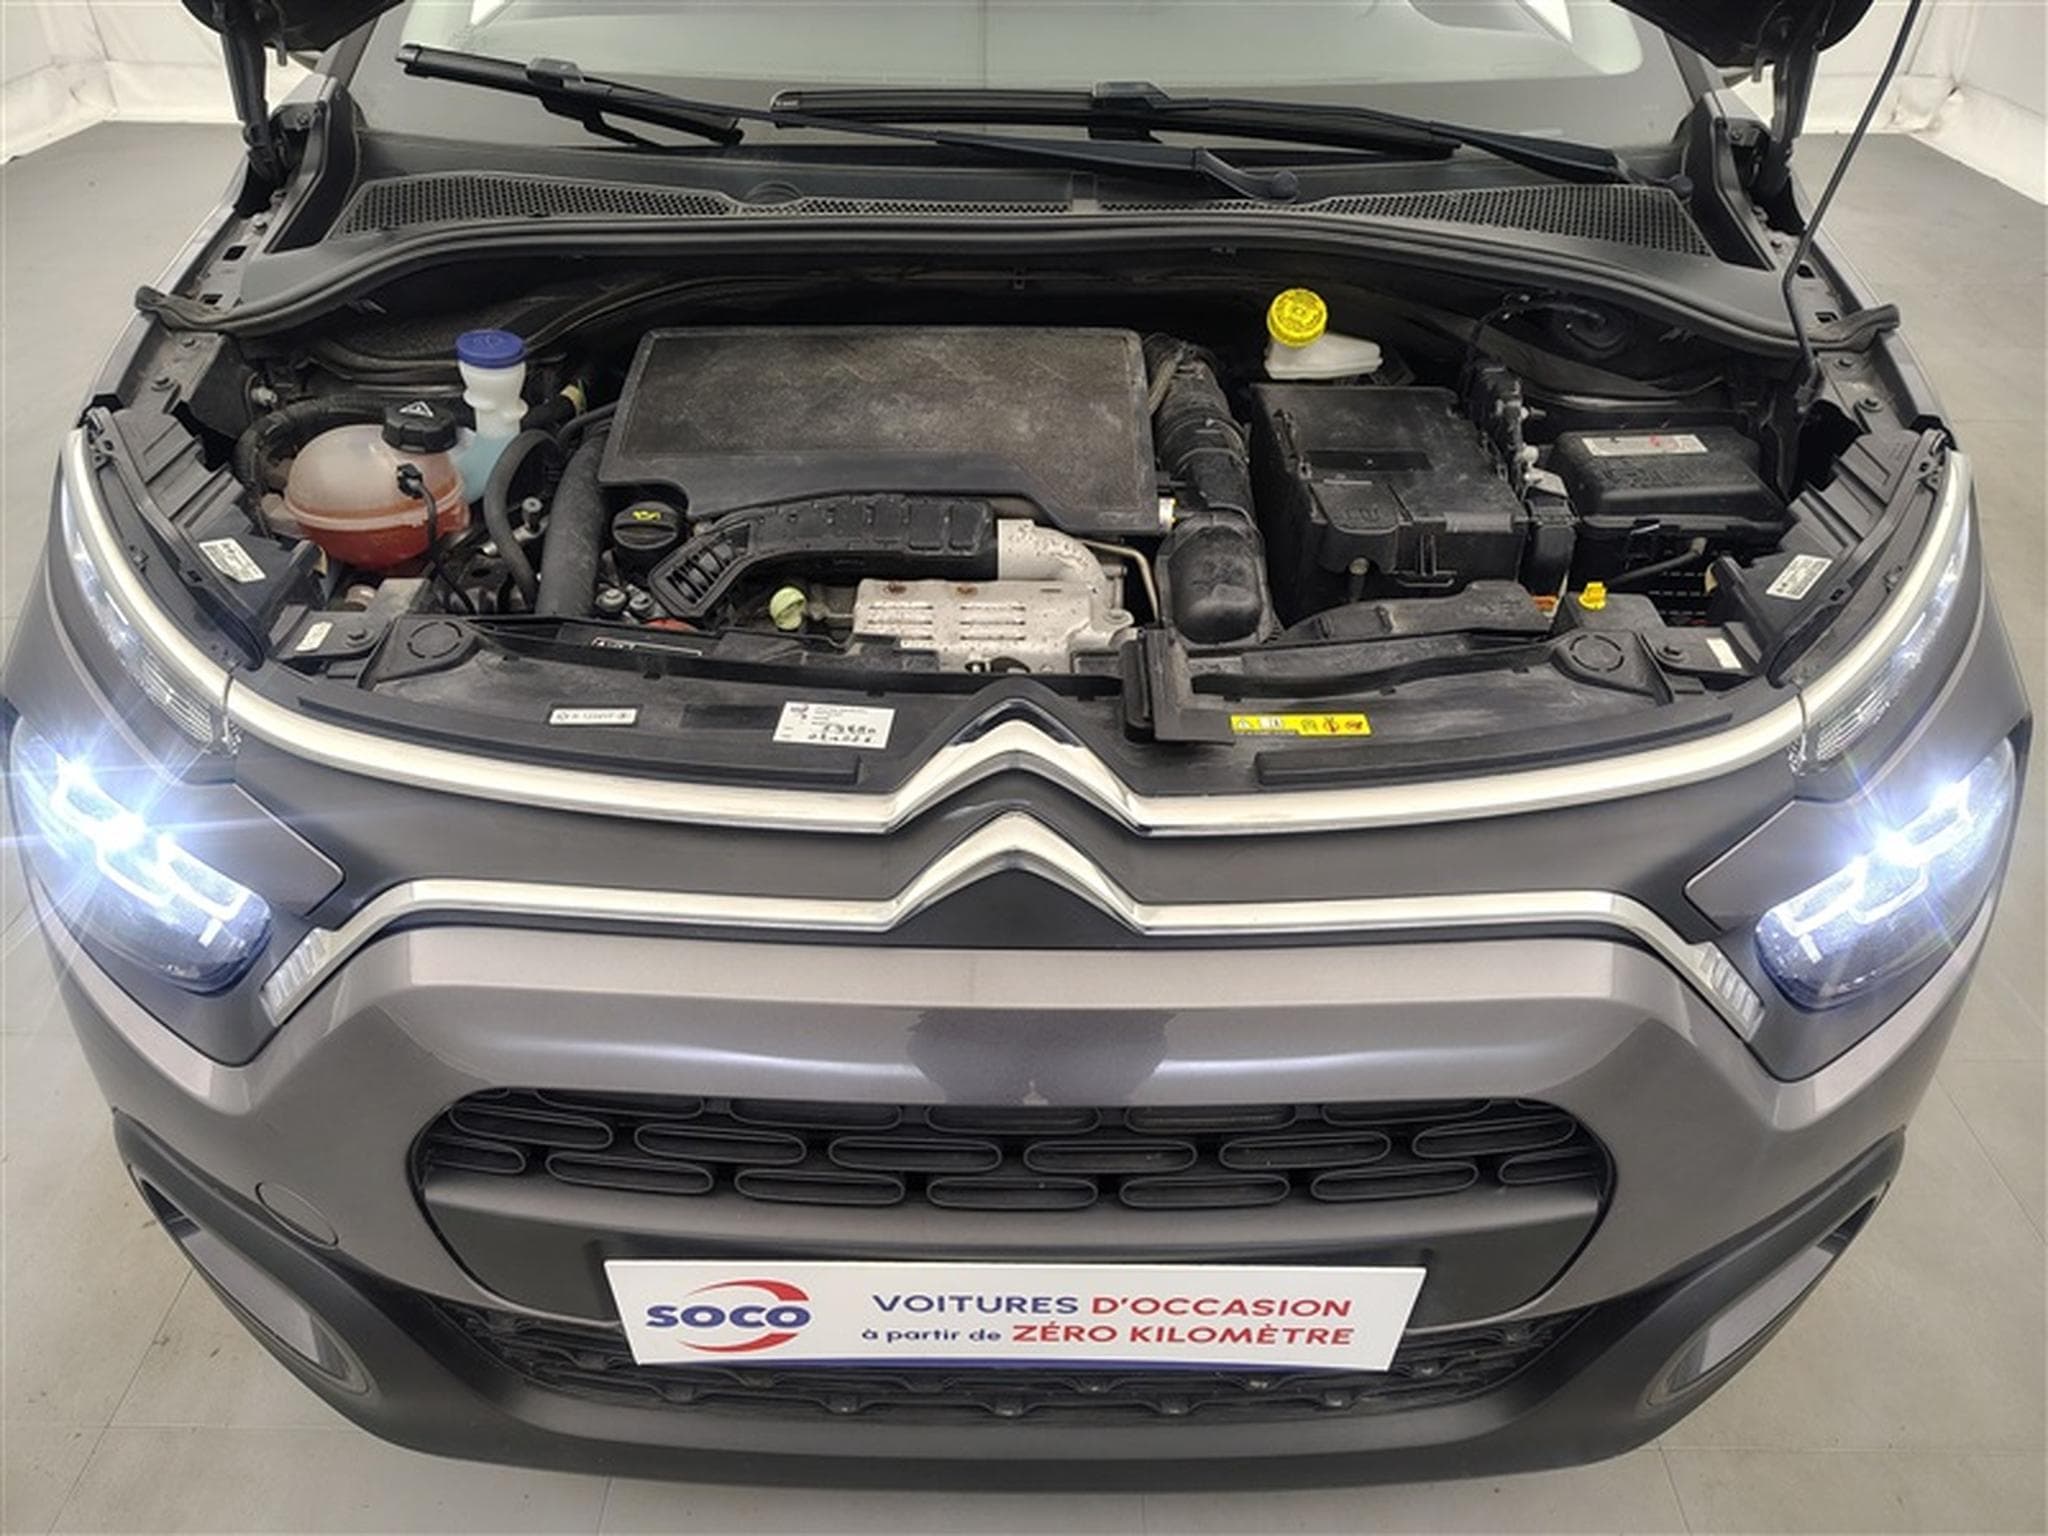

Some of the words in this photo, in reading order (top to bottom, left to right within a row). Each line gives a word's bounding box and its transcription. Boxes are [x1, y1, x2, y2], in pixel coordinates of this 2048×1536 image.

[646, 1305, 811, 1329] SOCO
[873, 1294, 1079, 1314] VOITURES
[1092, 1297, 1352, 1318] D'OCCASION
[862, 1327, 878, 1341] à
[887, 1325, 960, 1344] partir
[969, 1325, 1002, 1342] de
[1012, 1321, 1118, 1343] ZÉRO
[1130, 1323, 1355, 1345] KILOMÈTRE
